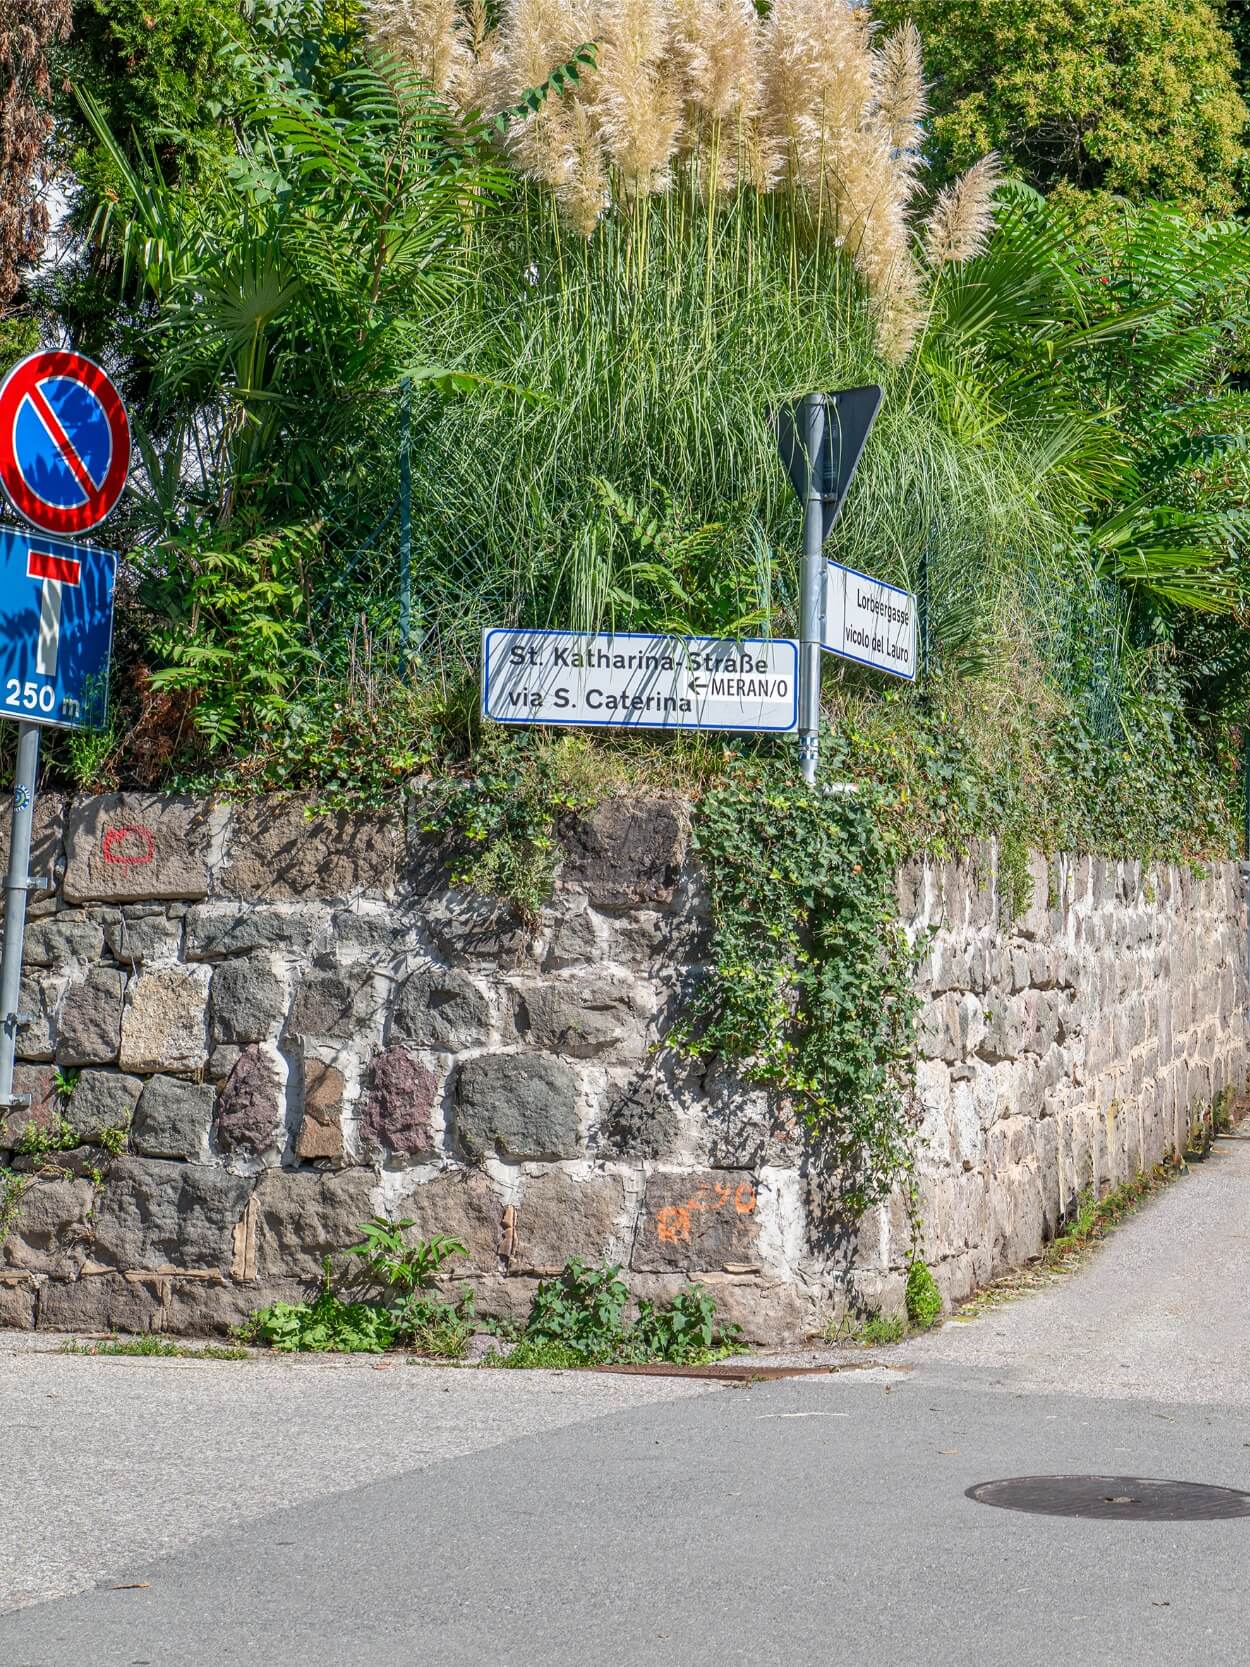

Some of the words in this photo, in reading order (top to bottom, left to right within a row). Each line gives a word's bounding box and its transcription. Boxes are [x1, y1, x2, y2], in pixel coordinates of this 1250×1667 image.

[857, 588, 909, 626] Lorbeergasse
[845, 624, 870, 649] vicolo
[871, 634, 884, 654] del
[886, 638, 909, 663] Lauro
[509, 645, 544, 666] St.
[553, 647, 769, 675] Katharina-Straße
[5, 678, 56, 712] 250
[508, 687, 543, 707] via
[552, 688, 577, 708] S.
[585, 689, 692, 713] Caterina
[711, 678, 788, 698] MERAN/O
